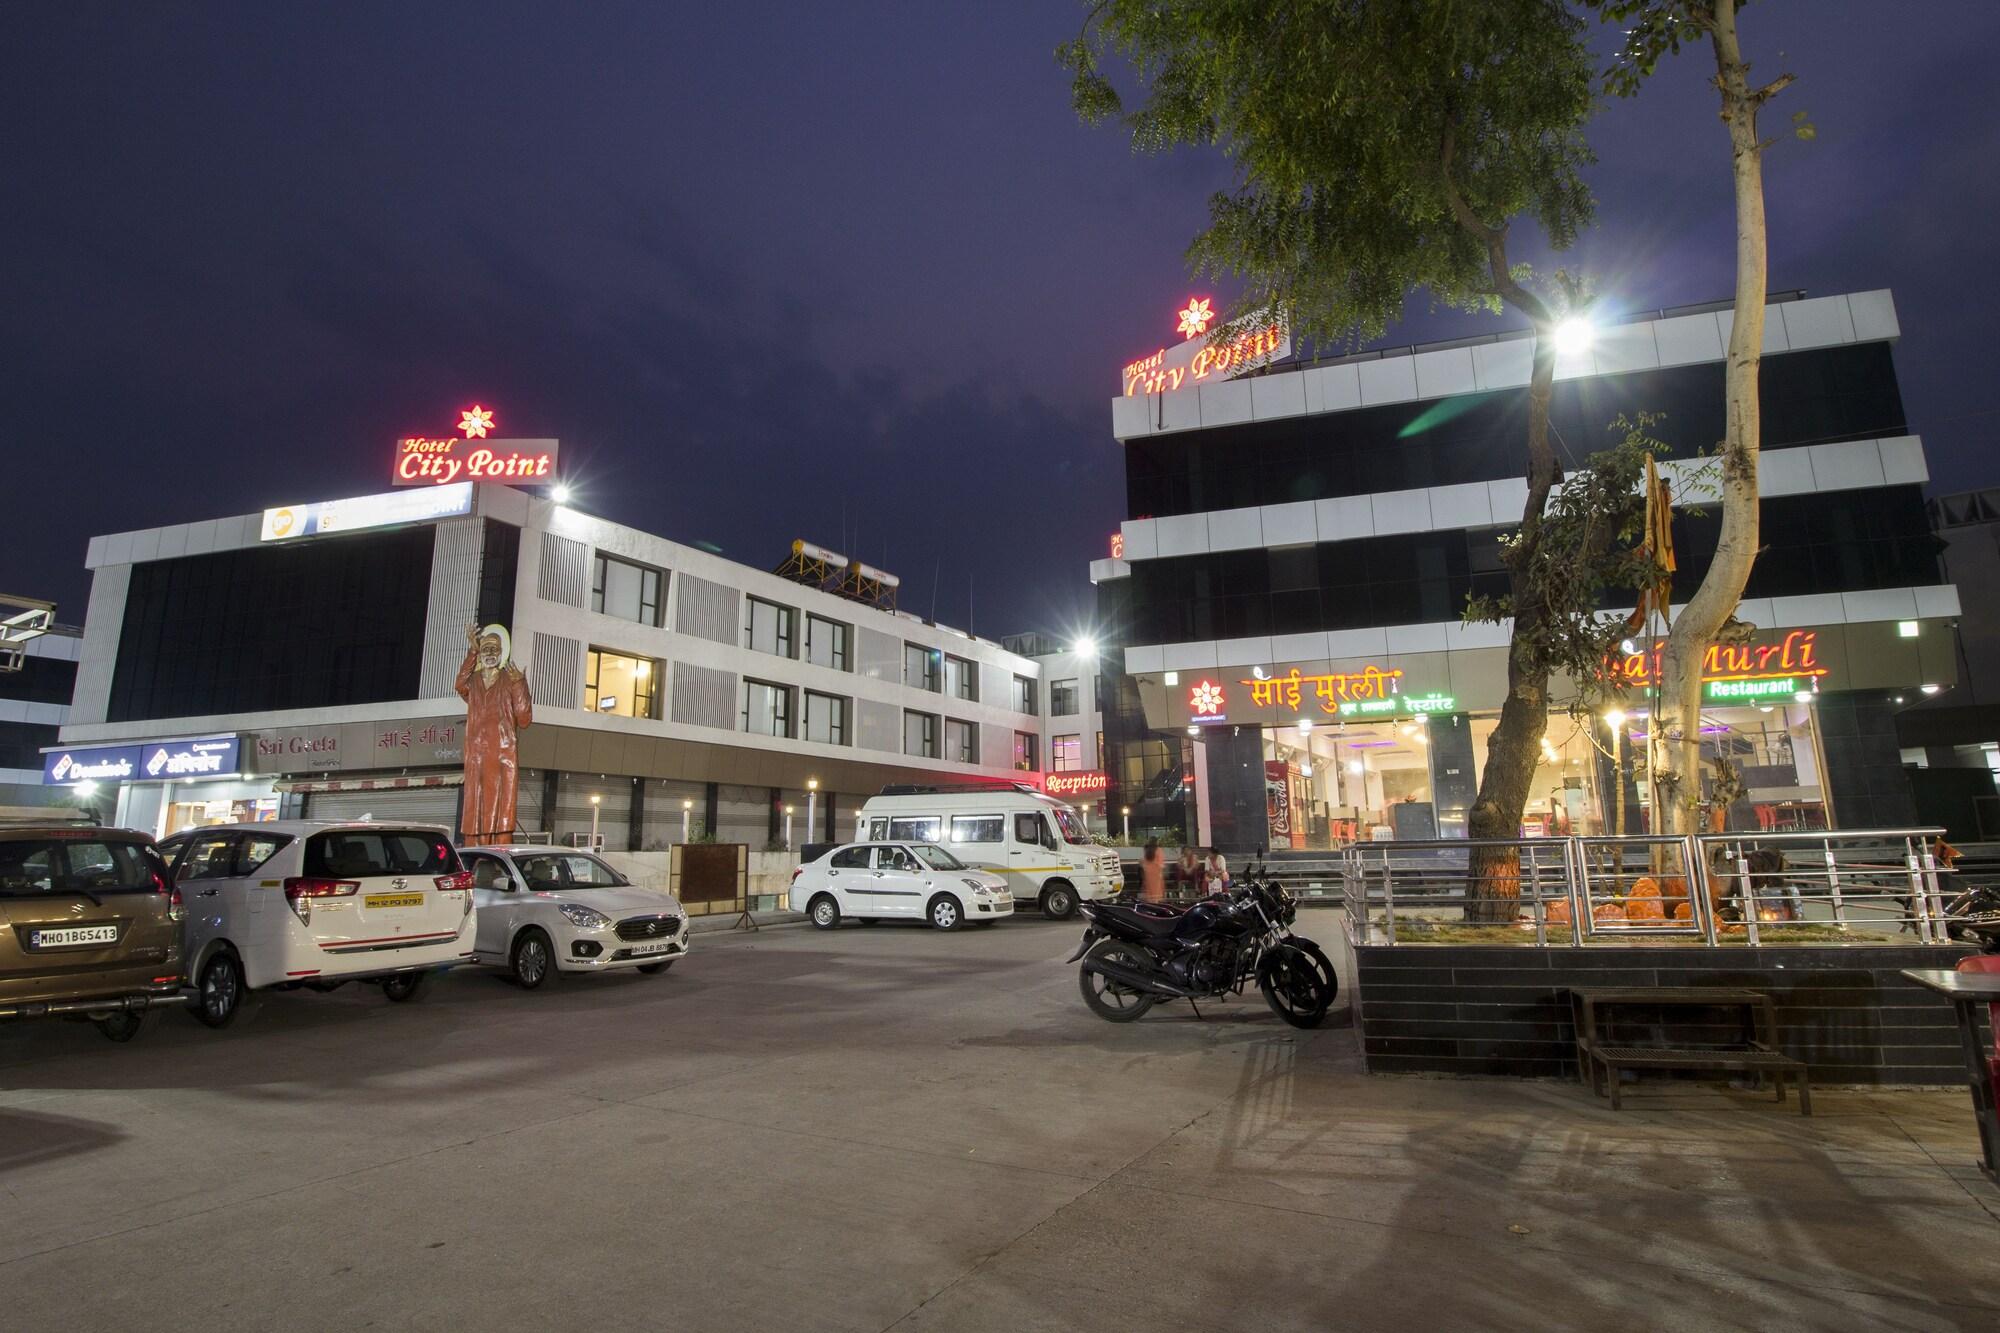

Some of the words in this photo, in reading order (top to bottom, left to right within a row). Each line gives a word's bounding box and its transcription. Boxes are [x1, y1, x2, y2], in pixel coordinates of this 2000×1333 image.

[1126, 348, 1165, 378] Hotel
[1127, 366, 1185, 397] City
[402, 438, 458, 453] Hotel
[399, 453, 461, 483] City
[467, 450, 549, 476] Point
[1314, 665, 1388, 713] मुरली
[1710, 678, 1794, 697] Restaurant
[258, 736, 284, 755] Sai
[1046, 773, 1107, 794] Reception
